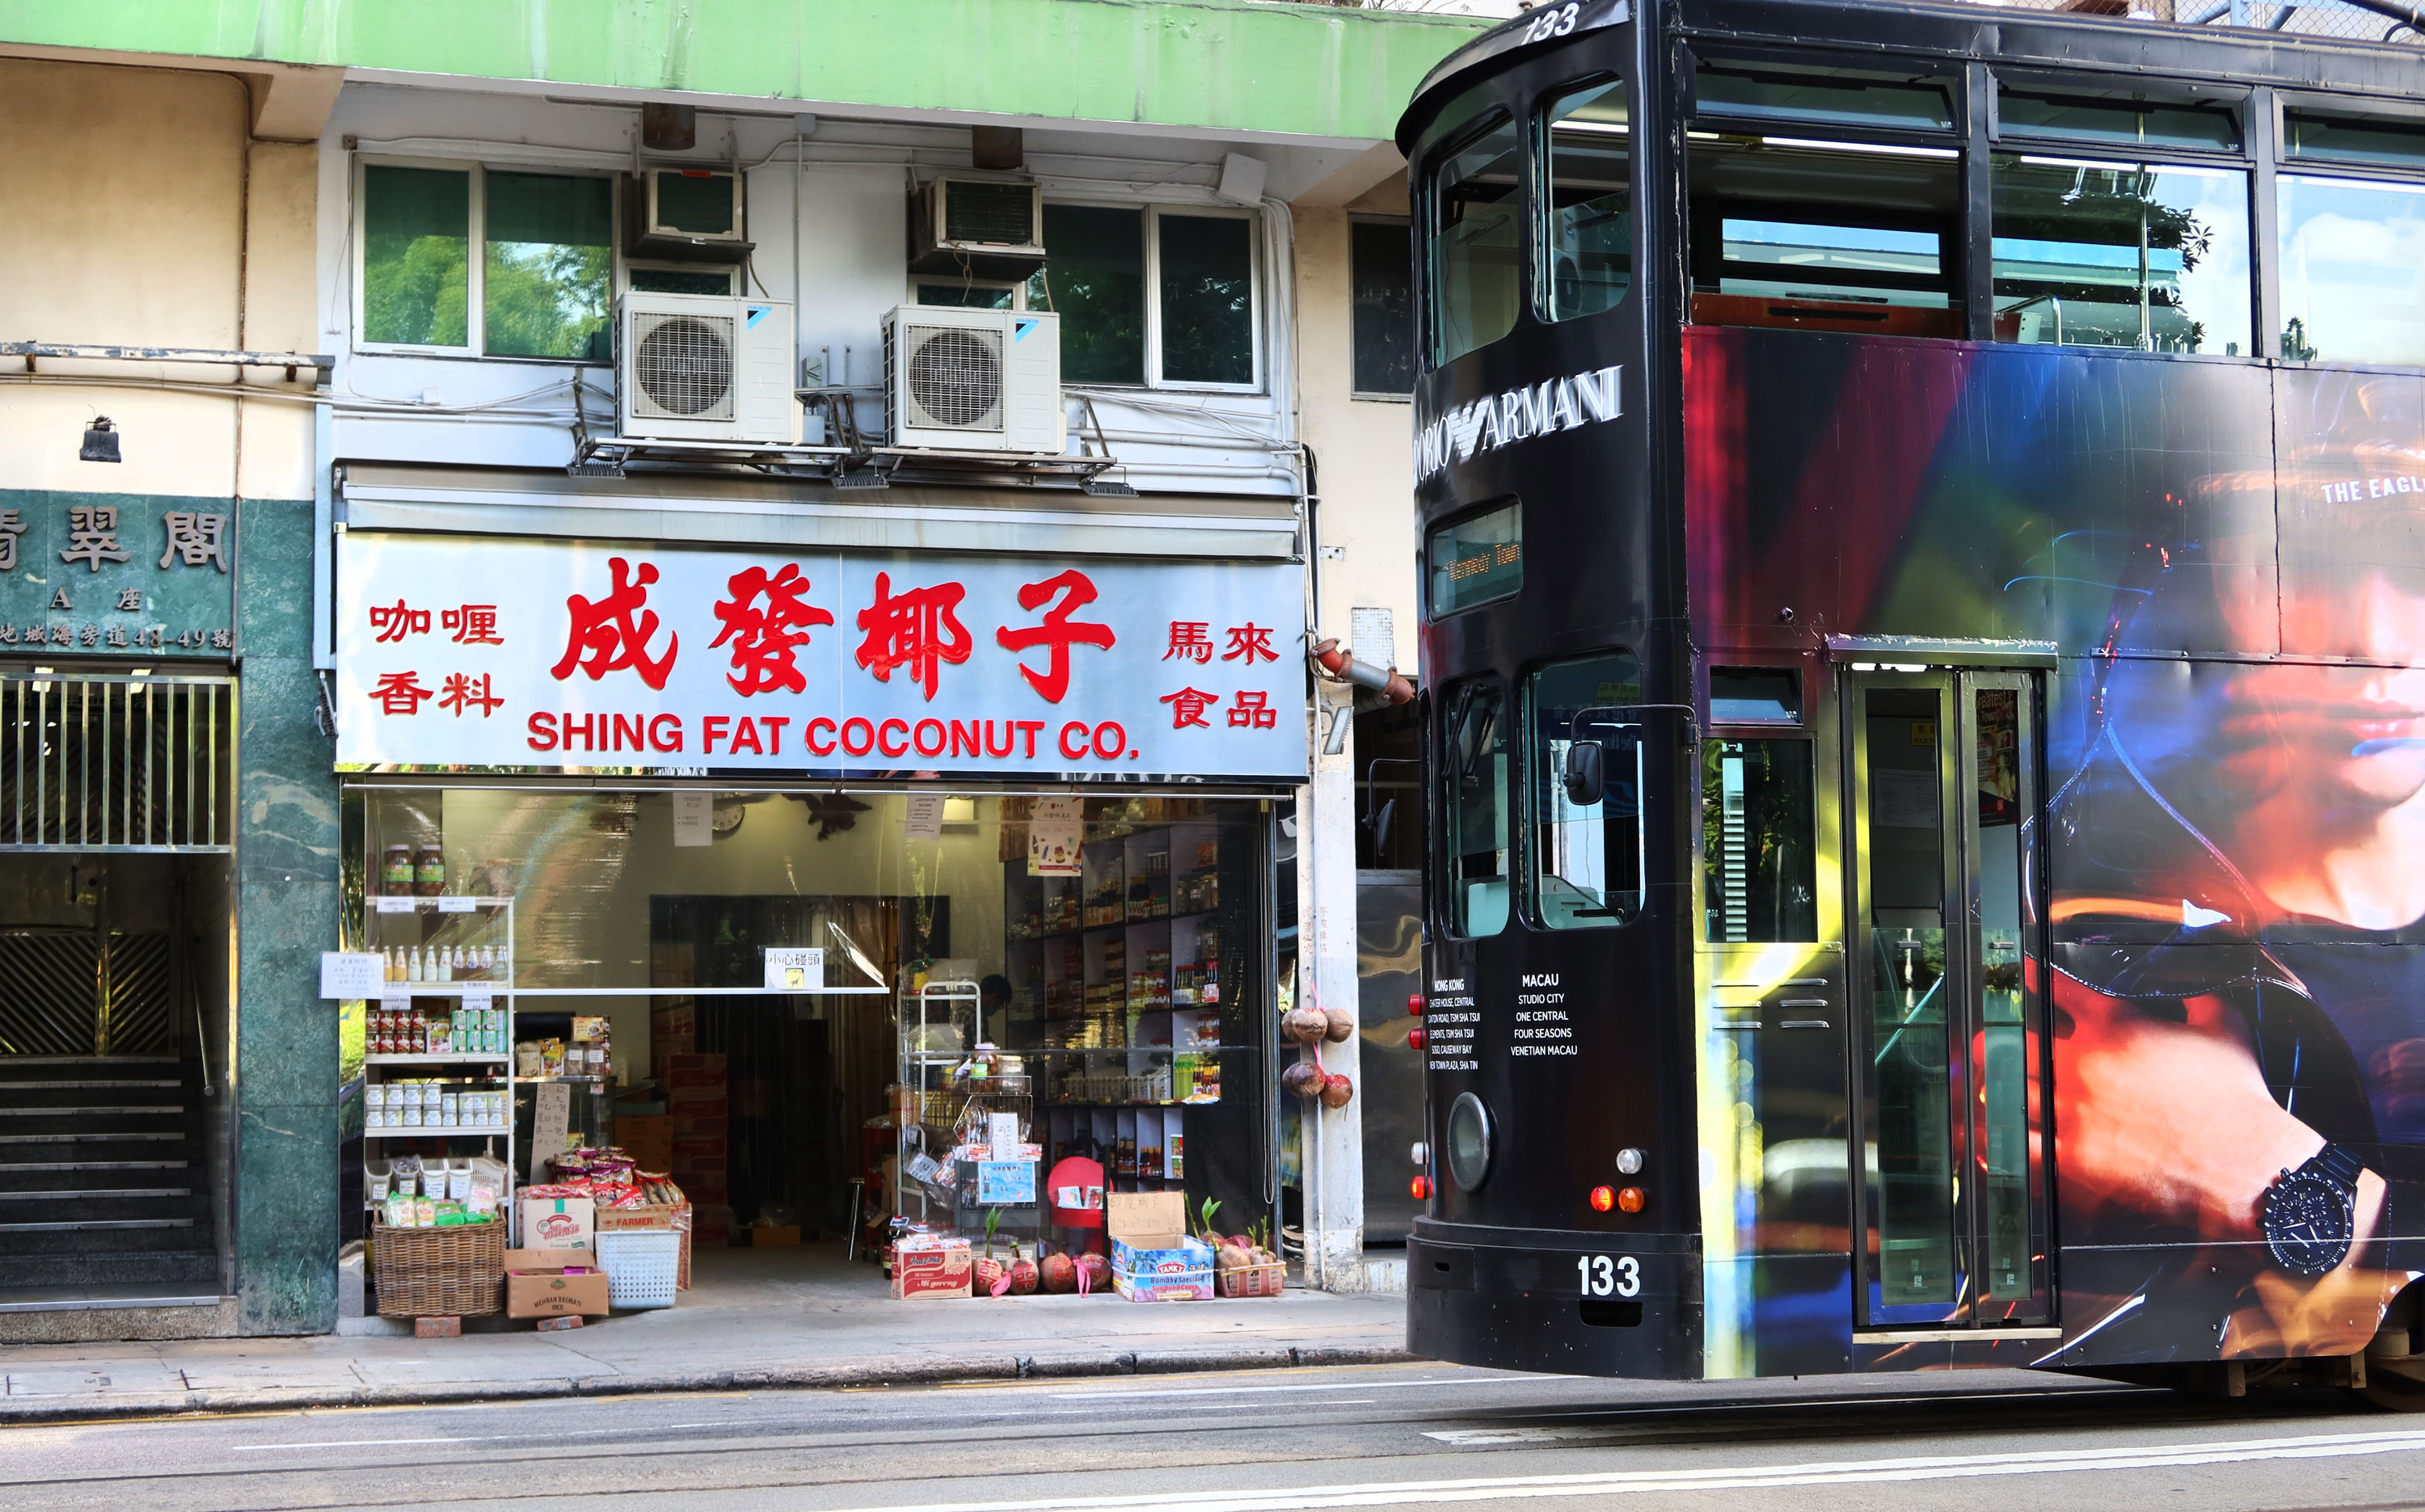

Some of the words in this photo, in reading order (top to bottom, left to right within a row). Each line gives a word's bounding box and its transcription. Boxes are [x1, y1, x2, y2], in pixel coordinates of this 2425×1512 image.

[1521, 2, 1579, 45] 133
[1482, 364, 1624, 451] ARMANI
[2321, 480, 2363, 503] THE
[2368, 476, 2425, 499] EAGL
[369, 598, 504, 646] 咖喱
[550, 557, 1116, 705] 成發椰子
[1162, 621, 1280, 665] 馬來
[368, 671, 505, 718] 香料
[1159, 686, 1277, 730] 食品
[527, 711, 684, 753] SHING
[702, 716, 790, 756] FAT
[804, 716, 1045, 760] COCONUT
[1058, 721, 1139, 760] CO.
[768, 953, 820, 966] 小心碰頭
[1434, 979, 1448, 992] HONG
[1449, 979, 1464, 992] KONG
[1522, 973, 1559, 988] MACAU
[1454, 997, 1475, 1007] CENTRAL
[1518, 994, 1545, 1004] STUDIO
[1546, 993, 1564, 1004] CITY
[1459, 1013, 1469, 1022] SHA
[1469, 1012, 1480, 1022] TSUI
[1516, 1012, 1531, 1021] ONE
[1533, 1011, 1569, 1021] CENTRAL
[1454, 1030, 1464, 1038] SHA
[1464, 1029, 1474, 1038] TSUI
[1514, 1029, 1533, 1038] FOUR
[1535, 1028, 1572, 1038] SEASONS
[1440, 1045, 1462, 1055] CAUSEWAY
[1462, 1045, 1473, 1054] BAY
[1511, 1046, 1546, 1056] VENETIAN
[1547, 1045, 1578, 1055] MACAU
[1459, 1060, 1469, 1070] SHA
[1469, 1060, 1478, 1070] TIN
[617, 1218, 654, 1226] FARMER
[1158, 1264, 1183, 1274] YANKY
[1577, 1255, 1641, 1297] 133
[534, 1296, 558, 1308] MEHRAN
[558, 1296, 582, 1308] BASMATI
